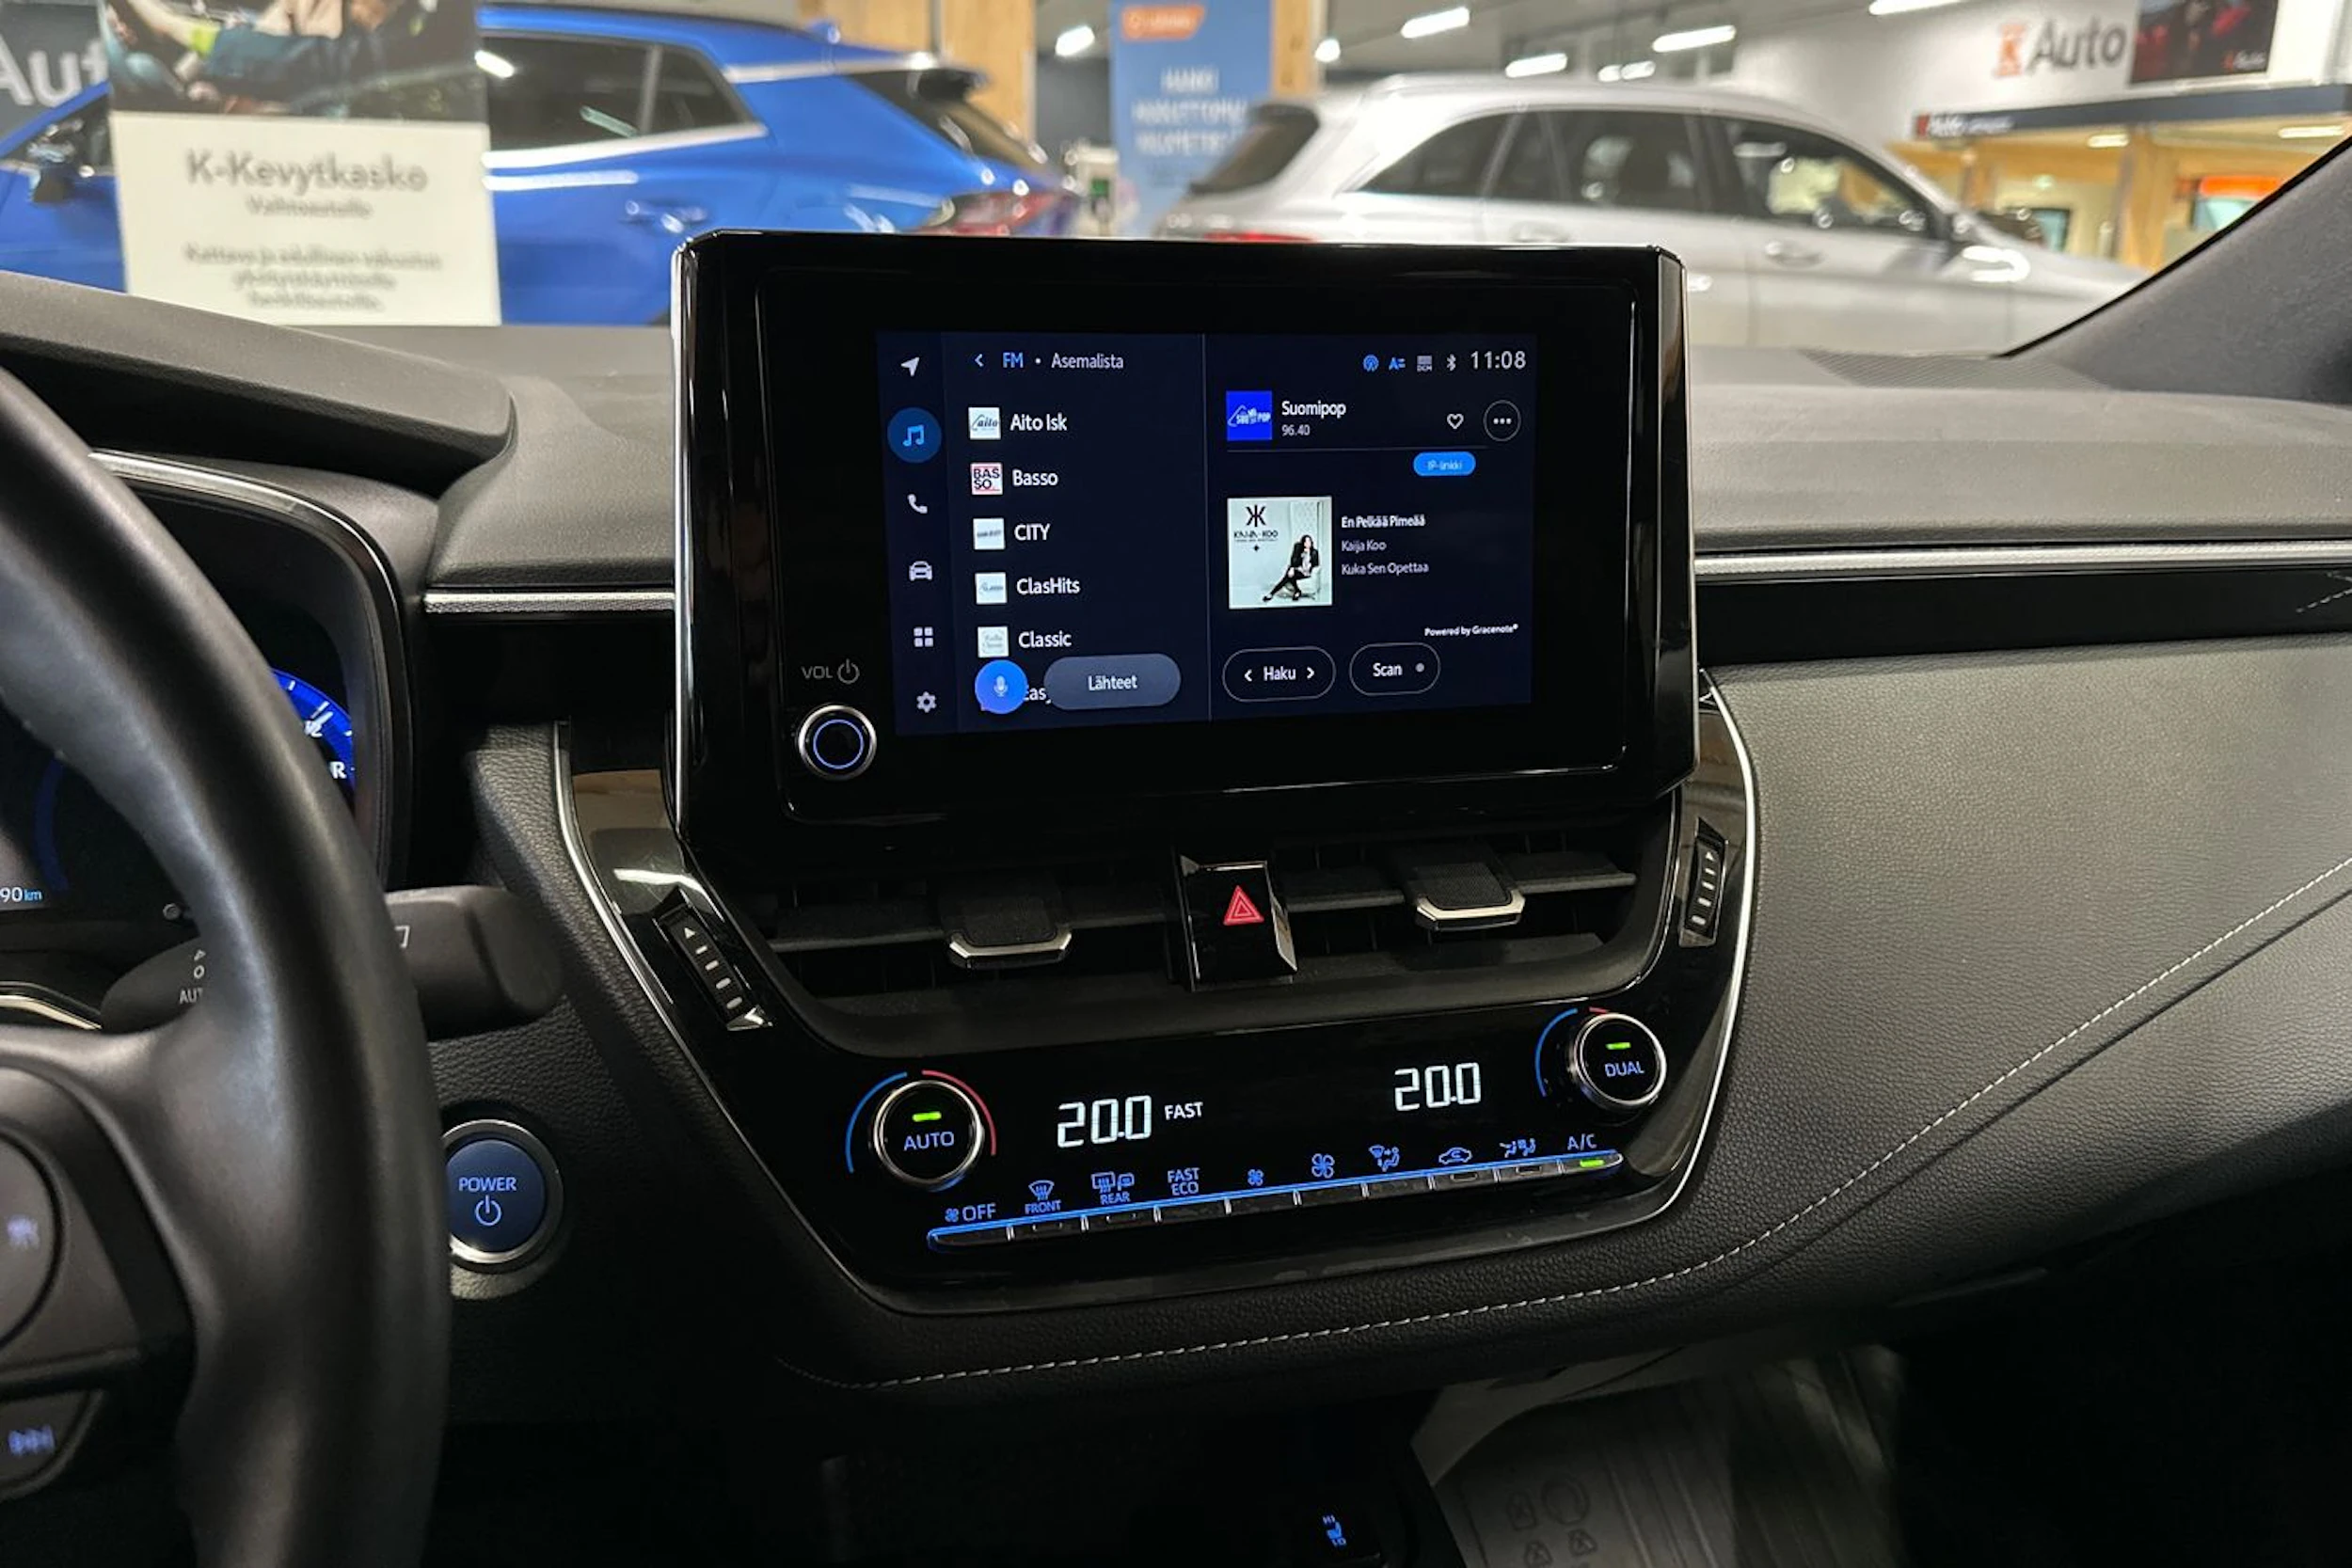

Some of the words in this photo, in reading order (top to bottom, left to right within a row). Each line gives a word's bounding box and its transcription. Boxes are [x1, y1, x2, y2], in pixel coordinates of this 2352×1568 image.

[2026, 17, 2127, 75] Auto
[0, 35, 108, 107] Aut
[185, 148, 429, 196] K-Kevytkasko
[1002, 352, 1024, 369] FM
[1051, 353, 1124, 369] Asemalista
[1470, 350, 1527, 370] 11:08
[1280, 400, 1347, 420] Suomipop
[1009, 412, 1043, 432] Aito
[1046, 412, 1068, 432] Isk
[1280, 424, 1311, 437] 96.40
[973, 467, 1000, 479] BAS
[1012, 468, 1059, 487] Basso
[973, 479, 993, 490] SO
[1341, 515, 1356, 529] En
[1013, 523, 1052, 541] CITY
[1341, 539, 1366, 554] Kaija
[1366, 539, 1388, 552] Koo
[1341, 562, 1367, 576] Kuka
[1367, 562, 1387, 575] Sen
[1387, 562, 1430, 577] Opettaa
[1016, 577, 1081, 595] ClasHits
[1018, 630, 1073, 649] Classic
[1423, 626, 1461, 637] Powered
[1460, 626, 1471, 638] by
[801, 666, 834, 680] VOL
[1263, 665, 1297, 683] Haku
[1372, 662, 1404, 678] Scan
[1088, 674, 1138, 691] Lähteet
[1025, 687, 1052, 705] as
[179, 986, 204, 1005] AUT
[1604, 1060, 1645, 1078] DUAL
[1393, 1062, 1483, 1112] 20.0
[1057, 1094, 1153, 1148] 20.0
[1164, 1101, 1204, 1121] FAST
[902, 1130, 956, 1152] AUTO
[1566, 1133, 1598, 1151] A/C
[1167, 1167, 1200, 1182] FAST
[457, 1176, 518, 1194] POWER
[1170, 1180, 1200, 1196] ECO
[1024, 1199, 1062, 1215] FRONT
[1100, 1191, 1131, 1205] REAR
[961, 1202, 997, 1221] OFF
